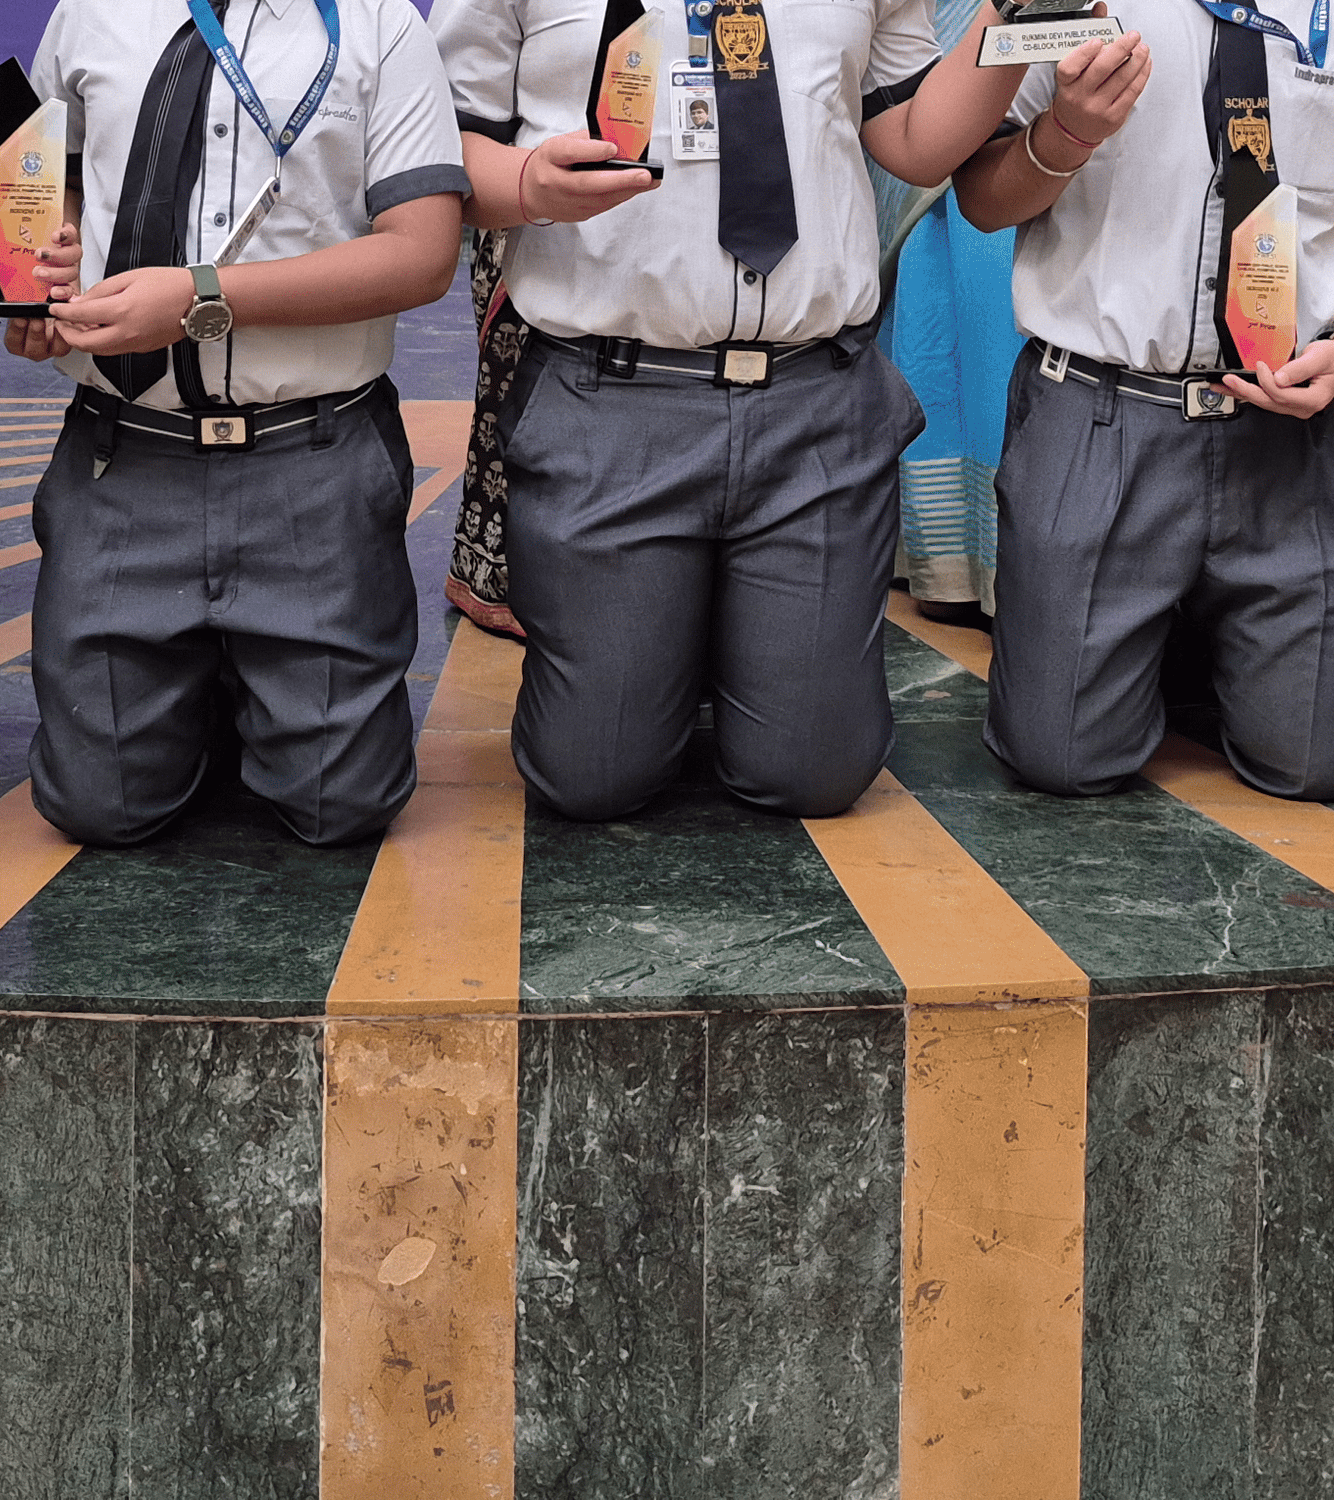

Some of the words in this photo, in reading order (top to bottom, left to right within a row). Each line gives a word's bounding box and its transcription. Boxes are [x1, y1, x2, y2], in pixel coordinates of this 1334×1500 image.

[1048, 32, 1063, 40] DEVI
[1064, 30, 1086, 39] PUBLIC
[1088, 28, 1114, 37] SCHOOL
[216, 47, 268, 129] Indraprastha
[289, 42, 337, 127] Indraprastha
[1224, 96, 1270, 109] SCHOLAR
